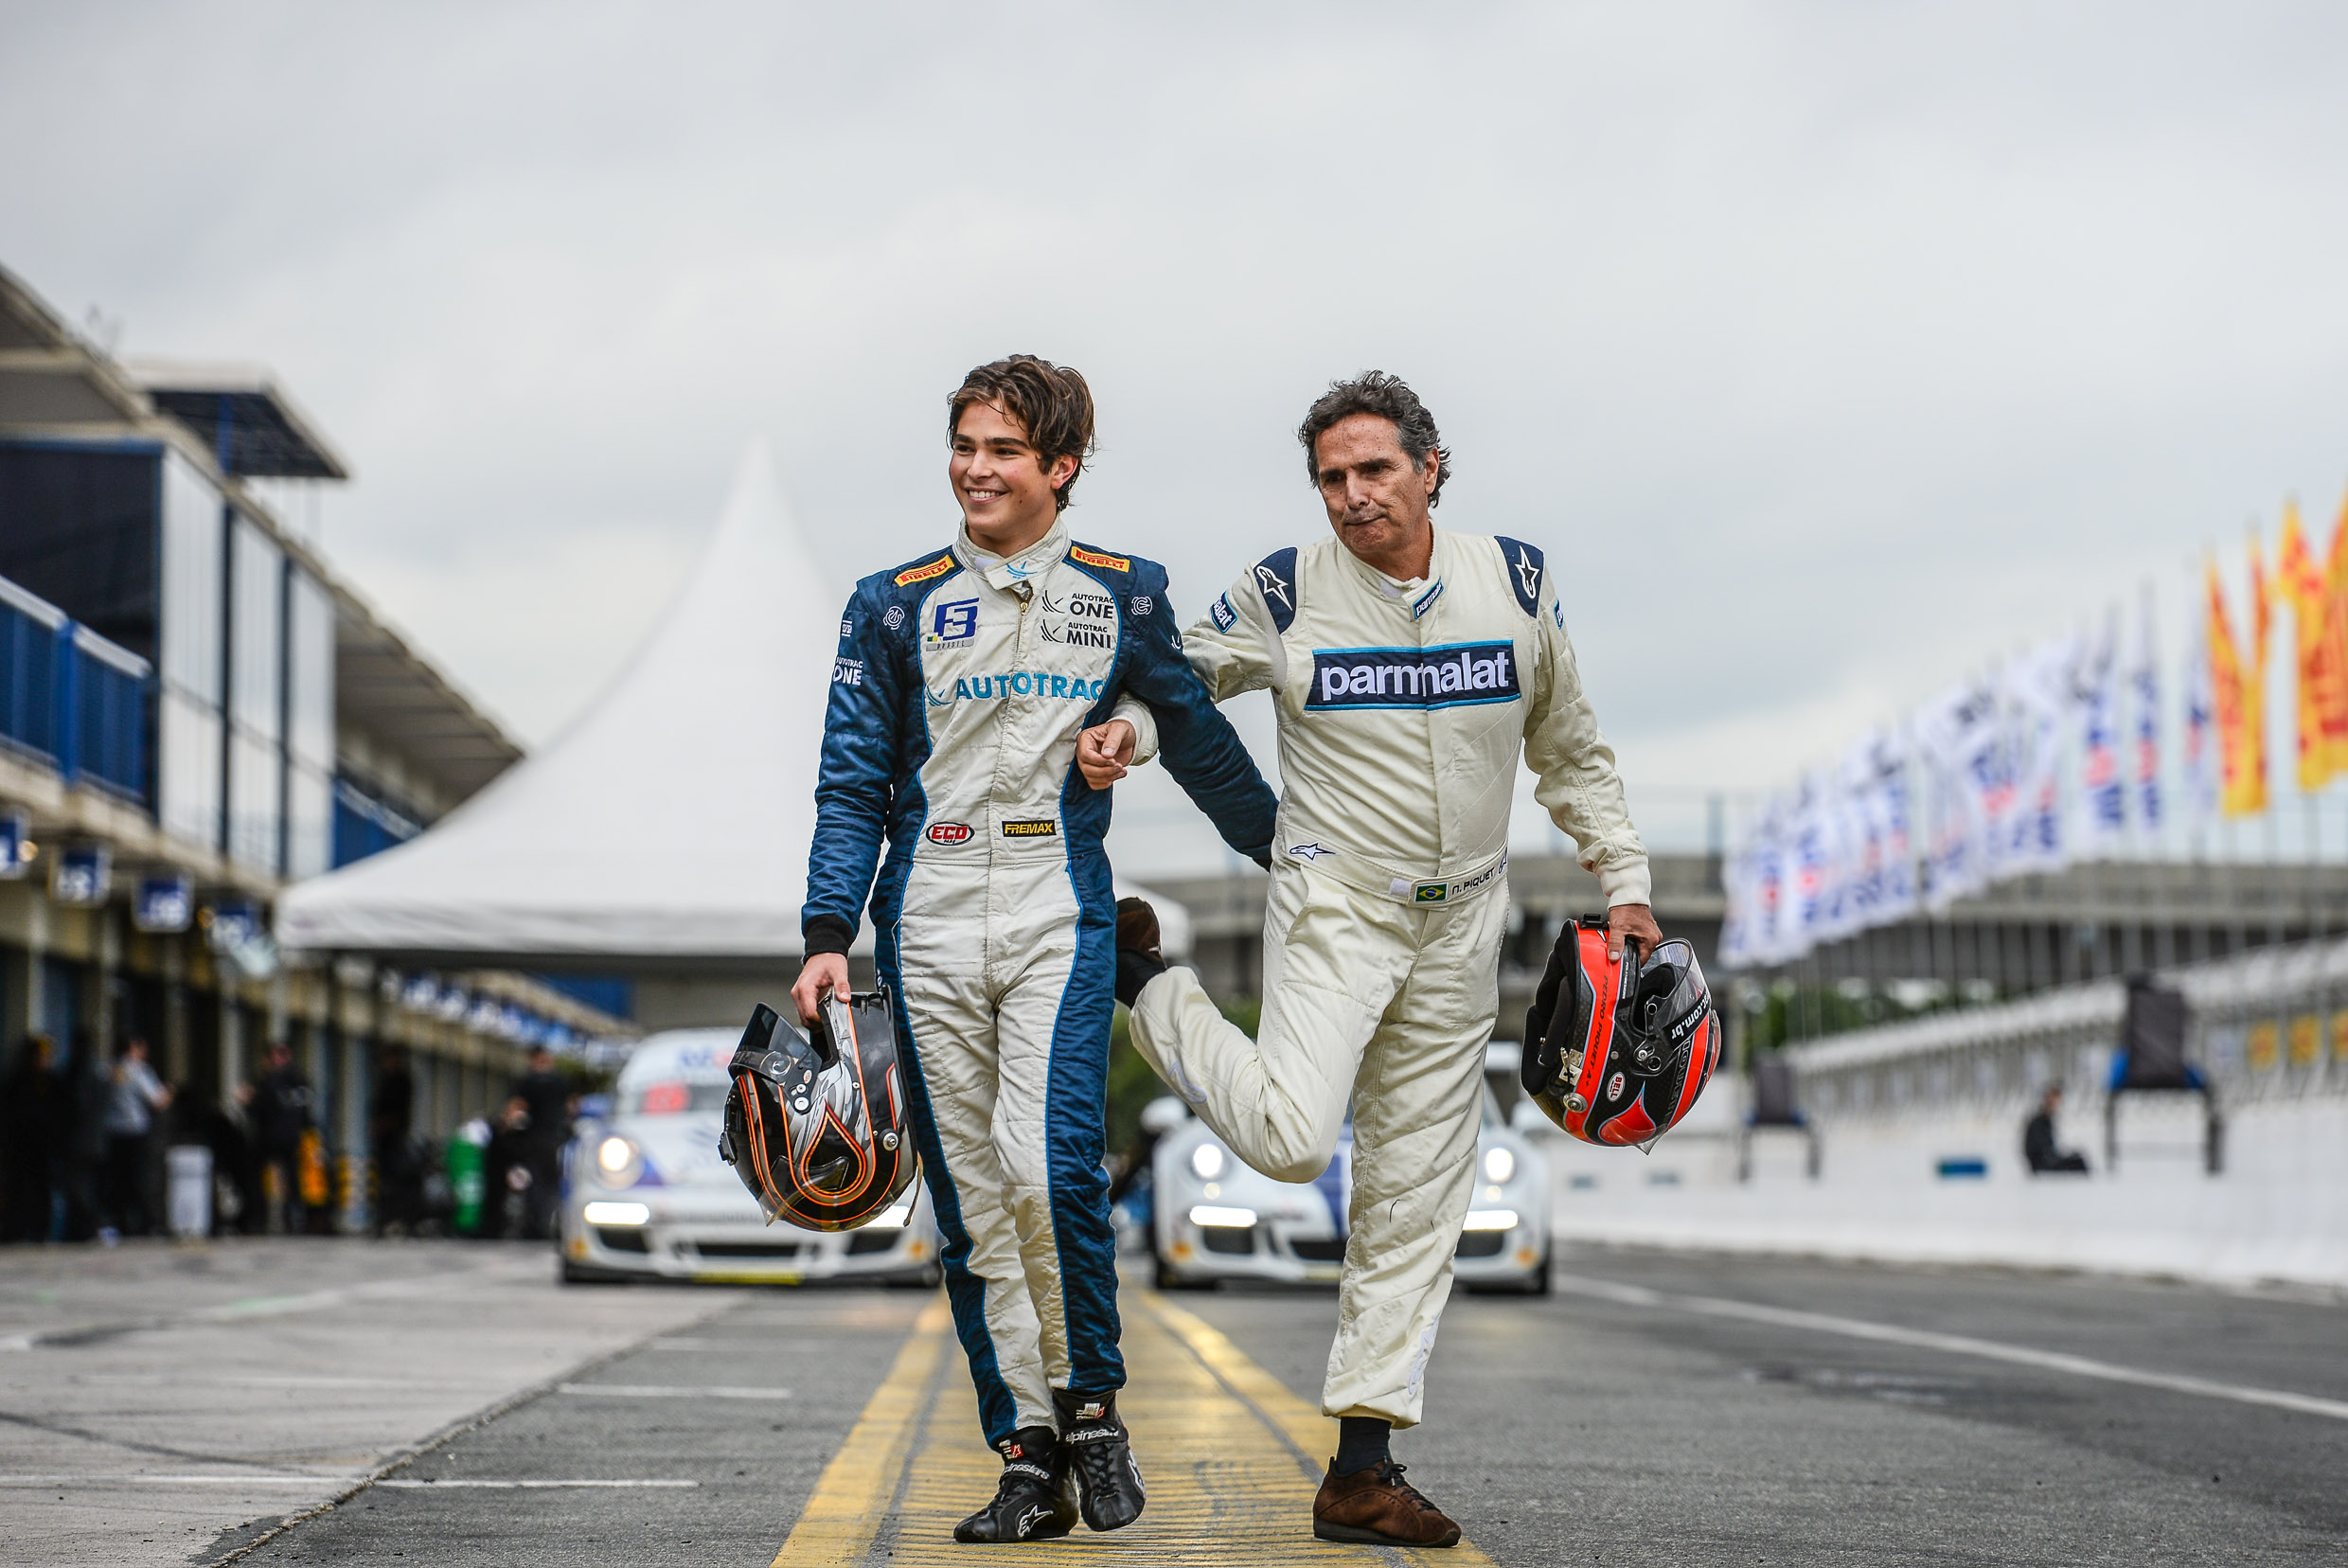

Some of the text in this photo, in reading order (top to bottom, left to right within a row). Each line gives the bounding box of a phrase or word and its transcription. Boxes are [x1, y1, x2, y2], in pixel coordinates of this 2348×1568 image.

[1076, 549, 1125, 569] PIRELLI
[899, 560, 948, 582] PIRELLI
[1071, 593, 1114, 604] AUTOTRAC
[1069, 600, 1114, 619] ONE
[1067, 622, 1108, 633] AUTOTRAC
[1066, 630, 1112, 650] MINI
[832, 665, 863, 686] ONE
[1321, 651, 1509, 702] parmalat
[955, 671, 1105, 702] AUTOTRAC
[1005, 823, 1053, 834] FREMAX
[1463, 866, 1495, 891] PIQUET
[1600, 974, 1609, 1020] PEDRO
[1610, 1076, 1623, 1099] BELL
